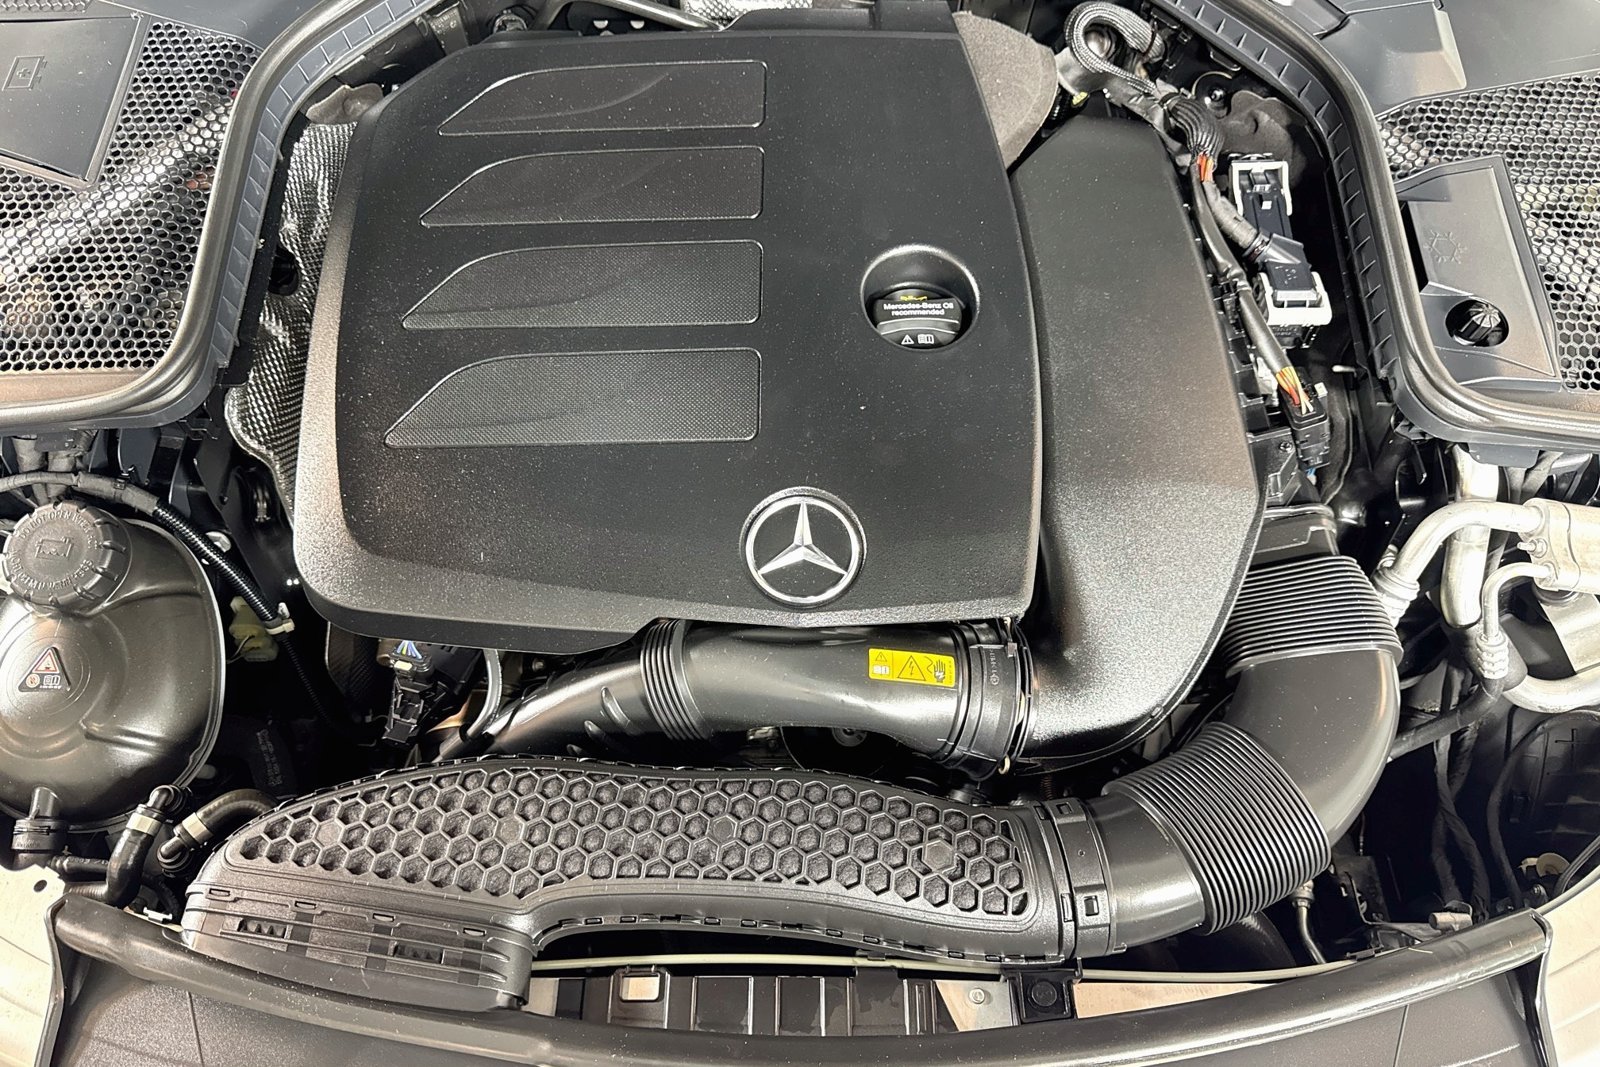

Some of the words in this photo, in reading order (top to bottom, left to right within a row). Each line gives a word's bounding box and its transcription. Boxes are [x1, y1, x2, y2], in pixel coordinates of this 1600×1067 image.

[882, 302, 942, 311] Mercedes-Benz
[891, 308, 945, 316] recommended
[49, 510, 71, 520] OPEN
